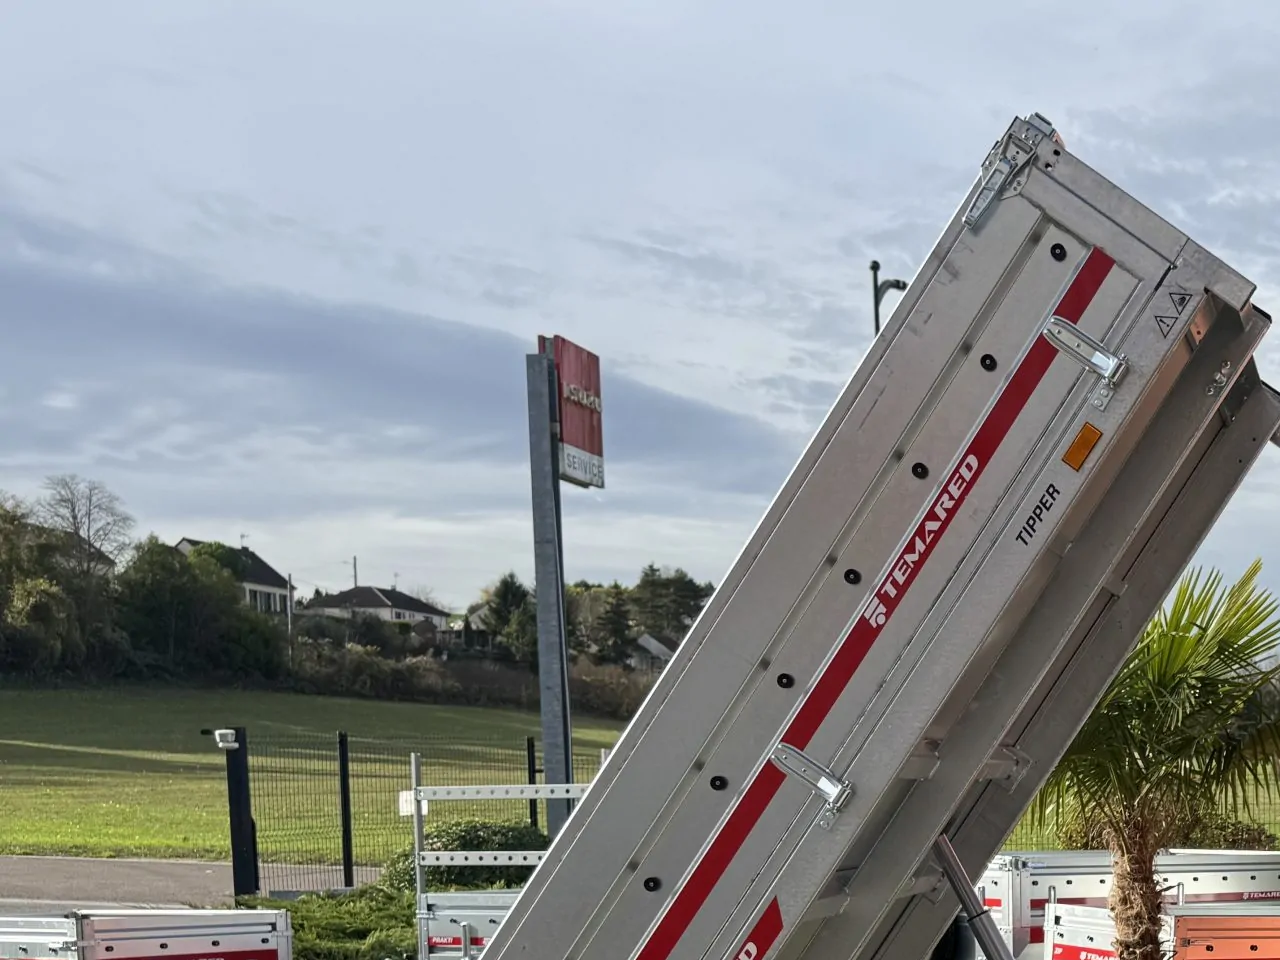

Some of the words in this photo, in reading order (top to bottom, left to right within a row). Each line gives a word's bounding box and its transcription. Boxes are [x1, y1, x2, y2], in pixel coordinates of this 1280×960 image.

[567, 453, 603, 478] SERVICE
[881, 454, 979, 599] TEMARED
[1015, 483, 1060, 546] TIPPER
